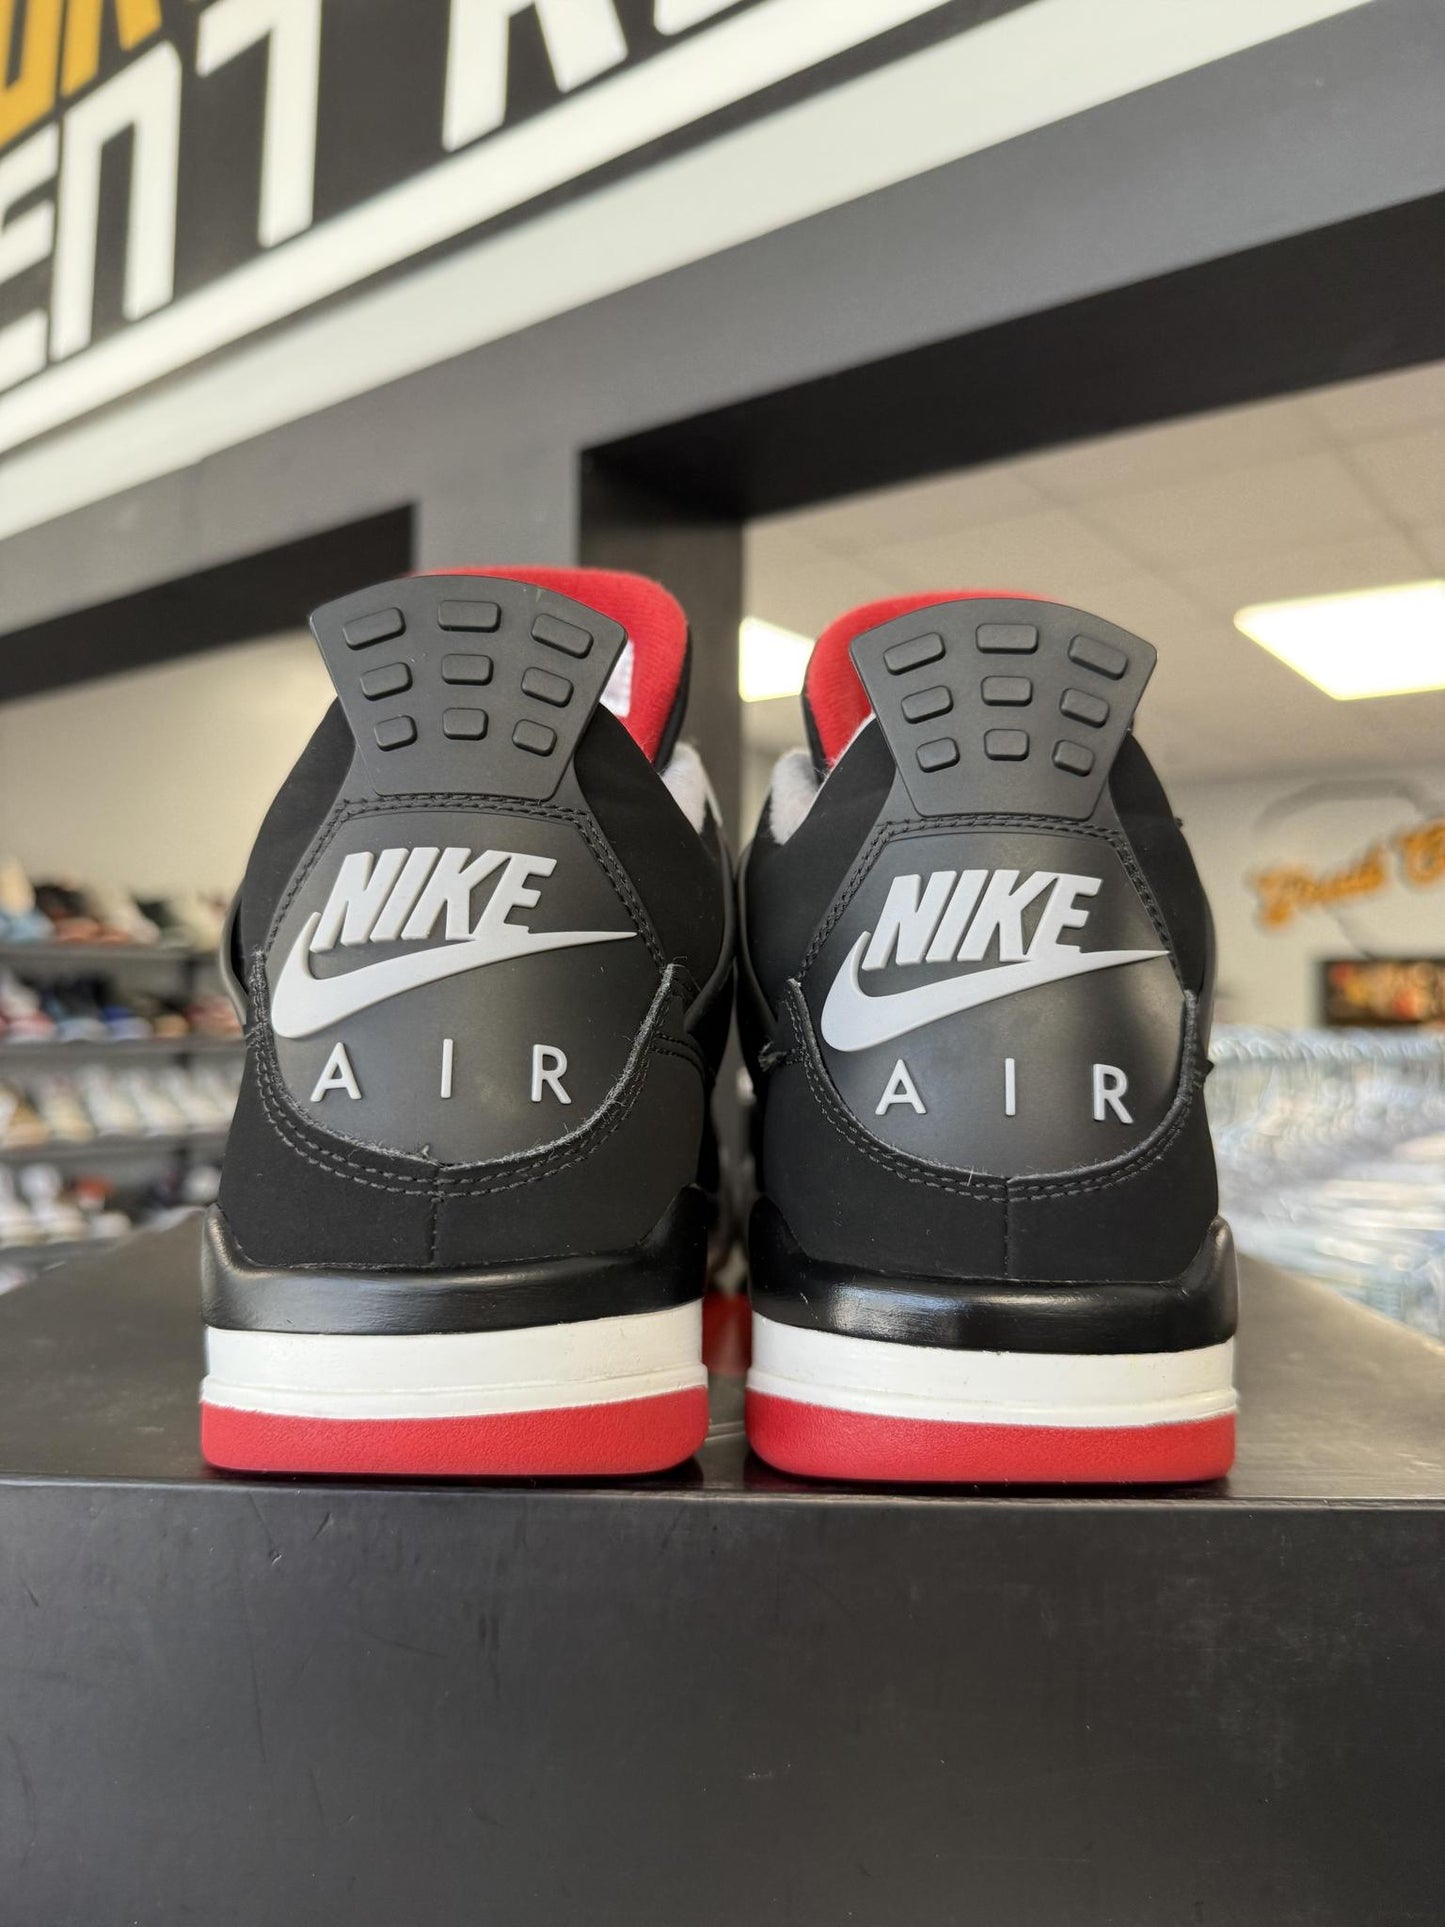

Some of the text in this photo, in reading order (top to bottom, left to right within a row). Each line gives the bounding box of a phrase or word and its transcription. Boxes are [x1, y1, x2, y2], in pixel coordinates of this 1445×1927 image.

[309, 846, 558, 953] NIKE
[861, 869, 1103, 970] NIKE
[310, 1038, 572, 1105] AIR
[875, 1057, 1133, 1124] AIR
